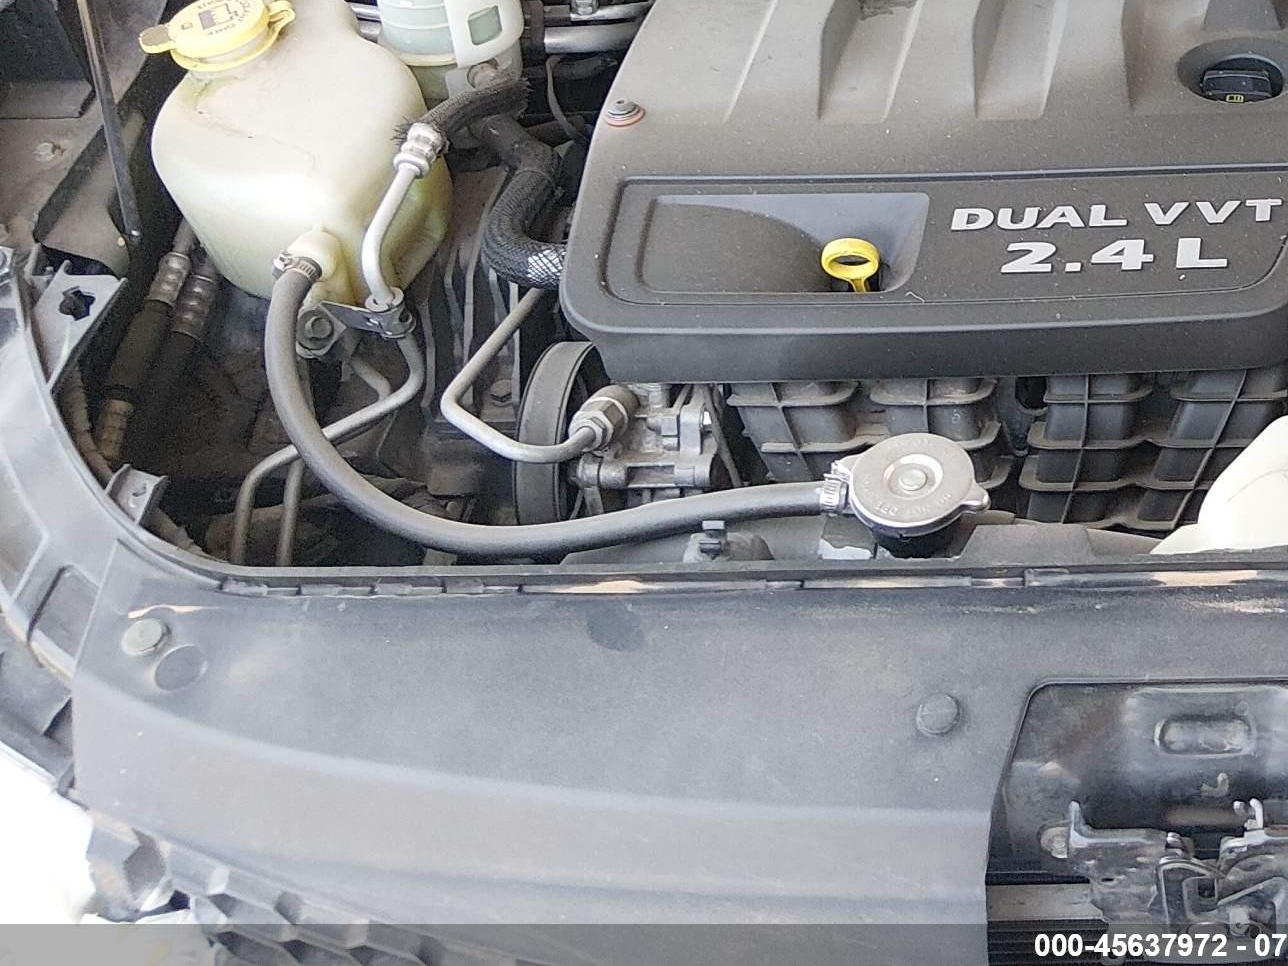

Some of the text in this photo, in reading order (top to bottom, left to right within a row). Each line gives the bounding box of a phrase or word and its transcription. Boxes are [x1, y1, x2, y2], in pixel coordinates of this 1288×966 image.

[950, 198, 1283, 232] DUAL VVT
[1000, 237, 1229, 274] 2.4 L
